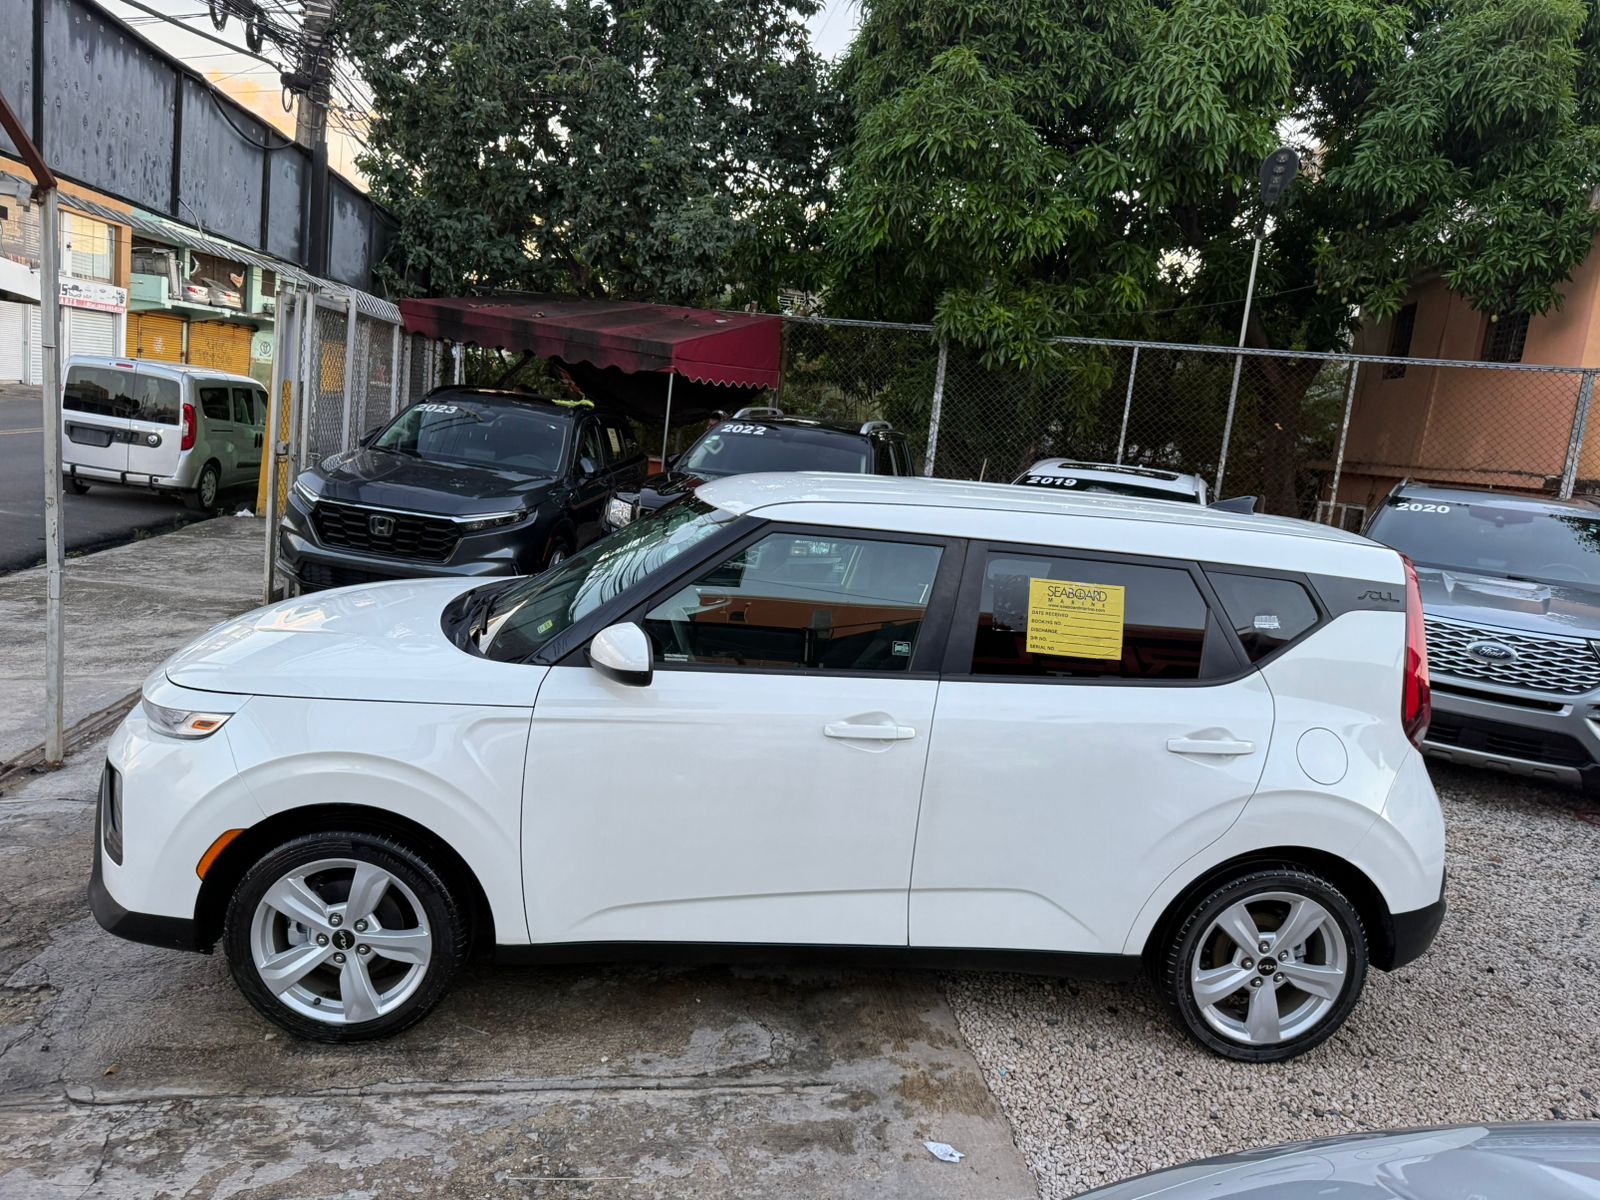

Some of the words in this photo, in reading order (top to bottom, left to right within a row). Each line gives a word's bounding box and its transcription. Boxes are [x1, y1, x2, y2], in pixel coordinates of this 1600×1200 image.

[414, 403, 458, 414] 2023
[720, 424, 767, 435] 2022
[1026, 476, 1077, 487] 2019
[1395, 502, 1450, 514] 2020
[1048, 586, 1108, 602] SEABOARD
[1047, 597, 1106, 608] MARINE
[1479, 646, 1506, 657] Ford
